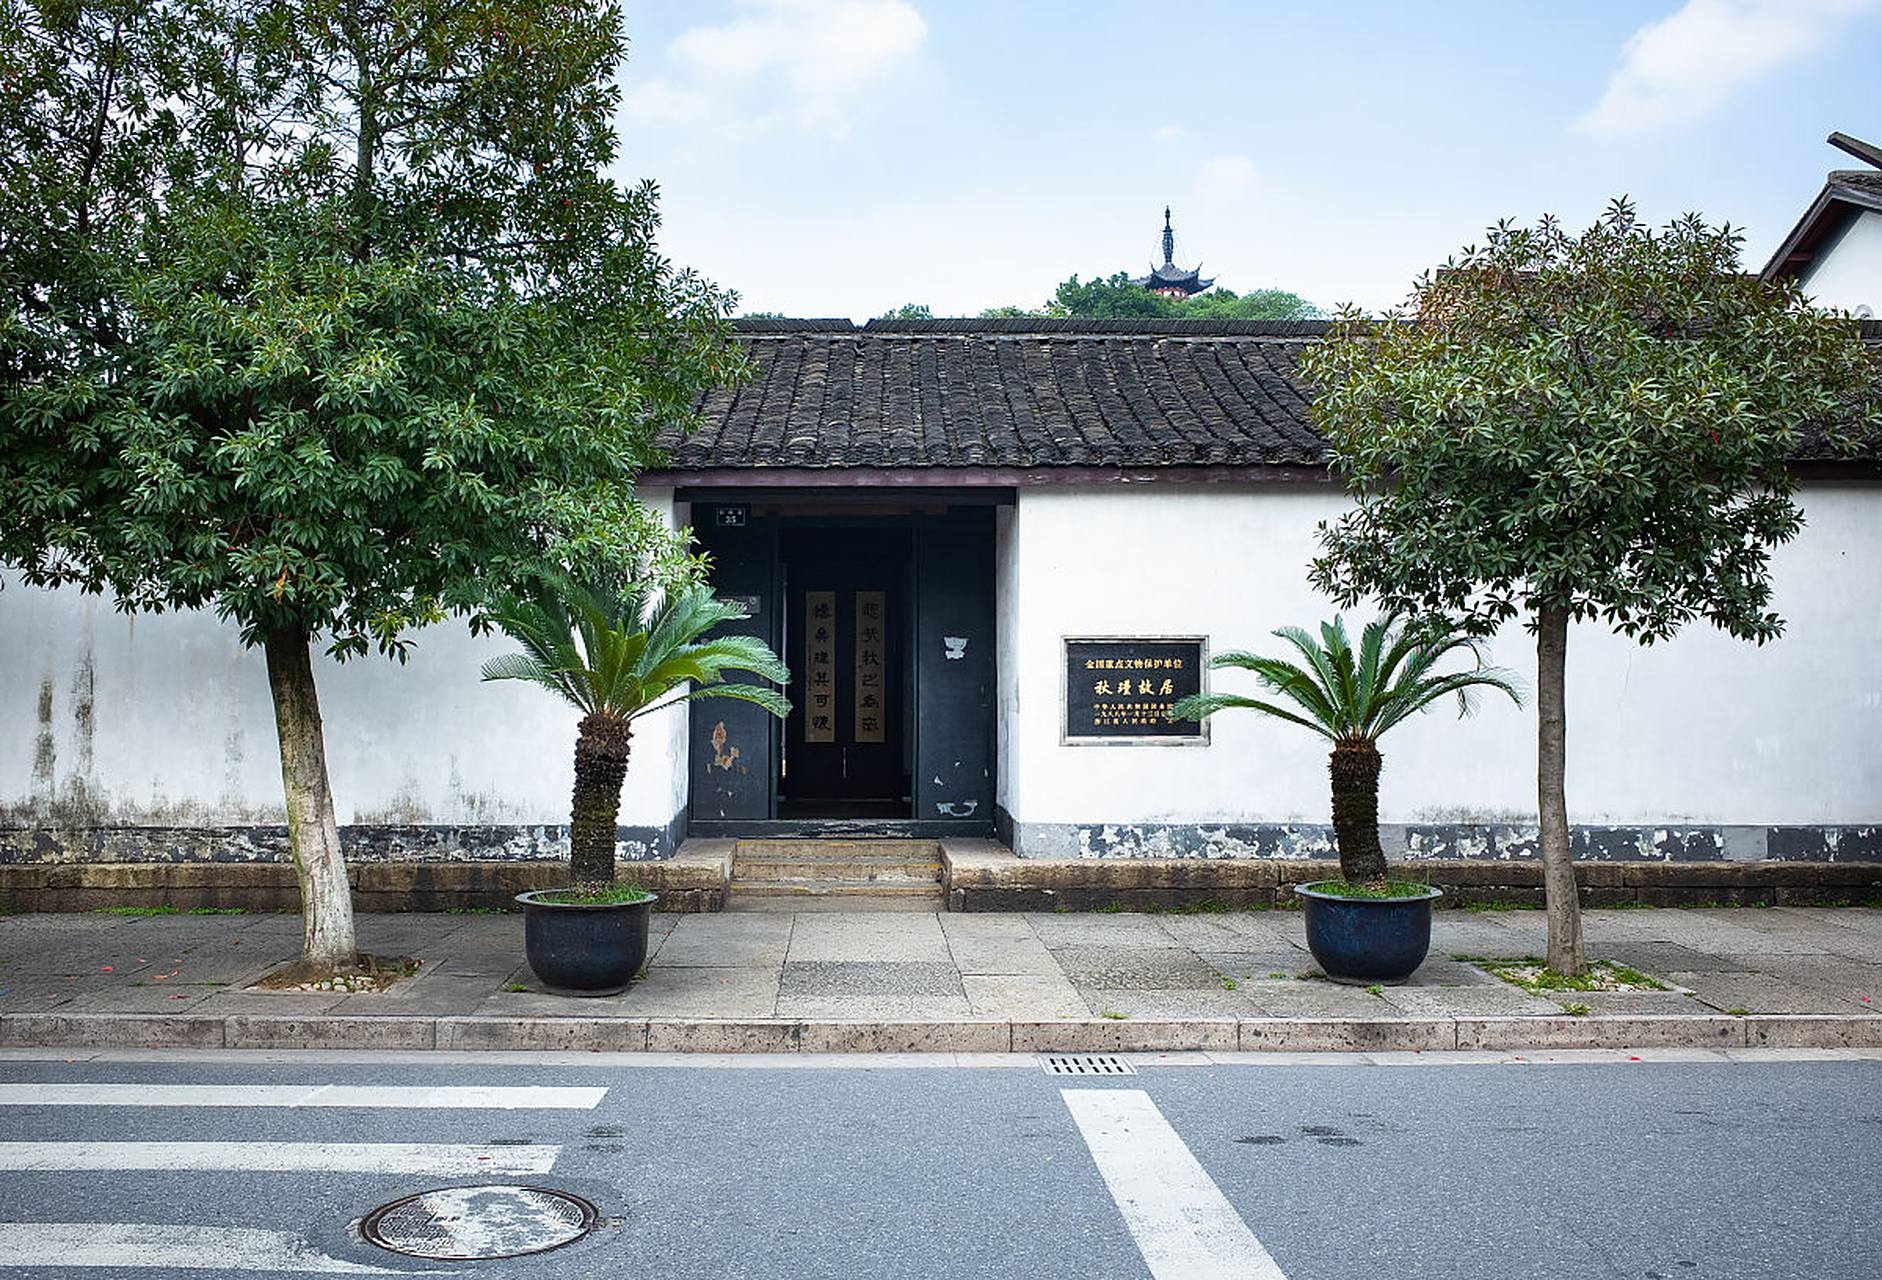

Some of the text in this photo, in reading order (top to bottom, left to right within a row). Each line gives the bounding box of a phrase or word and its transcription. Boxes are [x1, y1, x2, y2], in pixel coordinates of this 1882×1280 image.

[1085, 659, 1183, 670] 全国重点文物保护单位
[1094, 679, 1175, 696] 秋瑾故居
